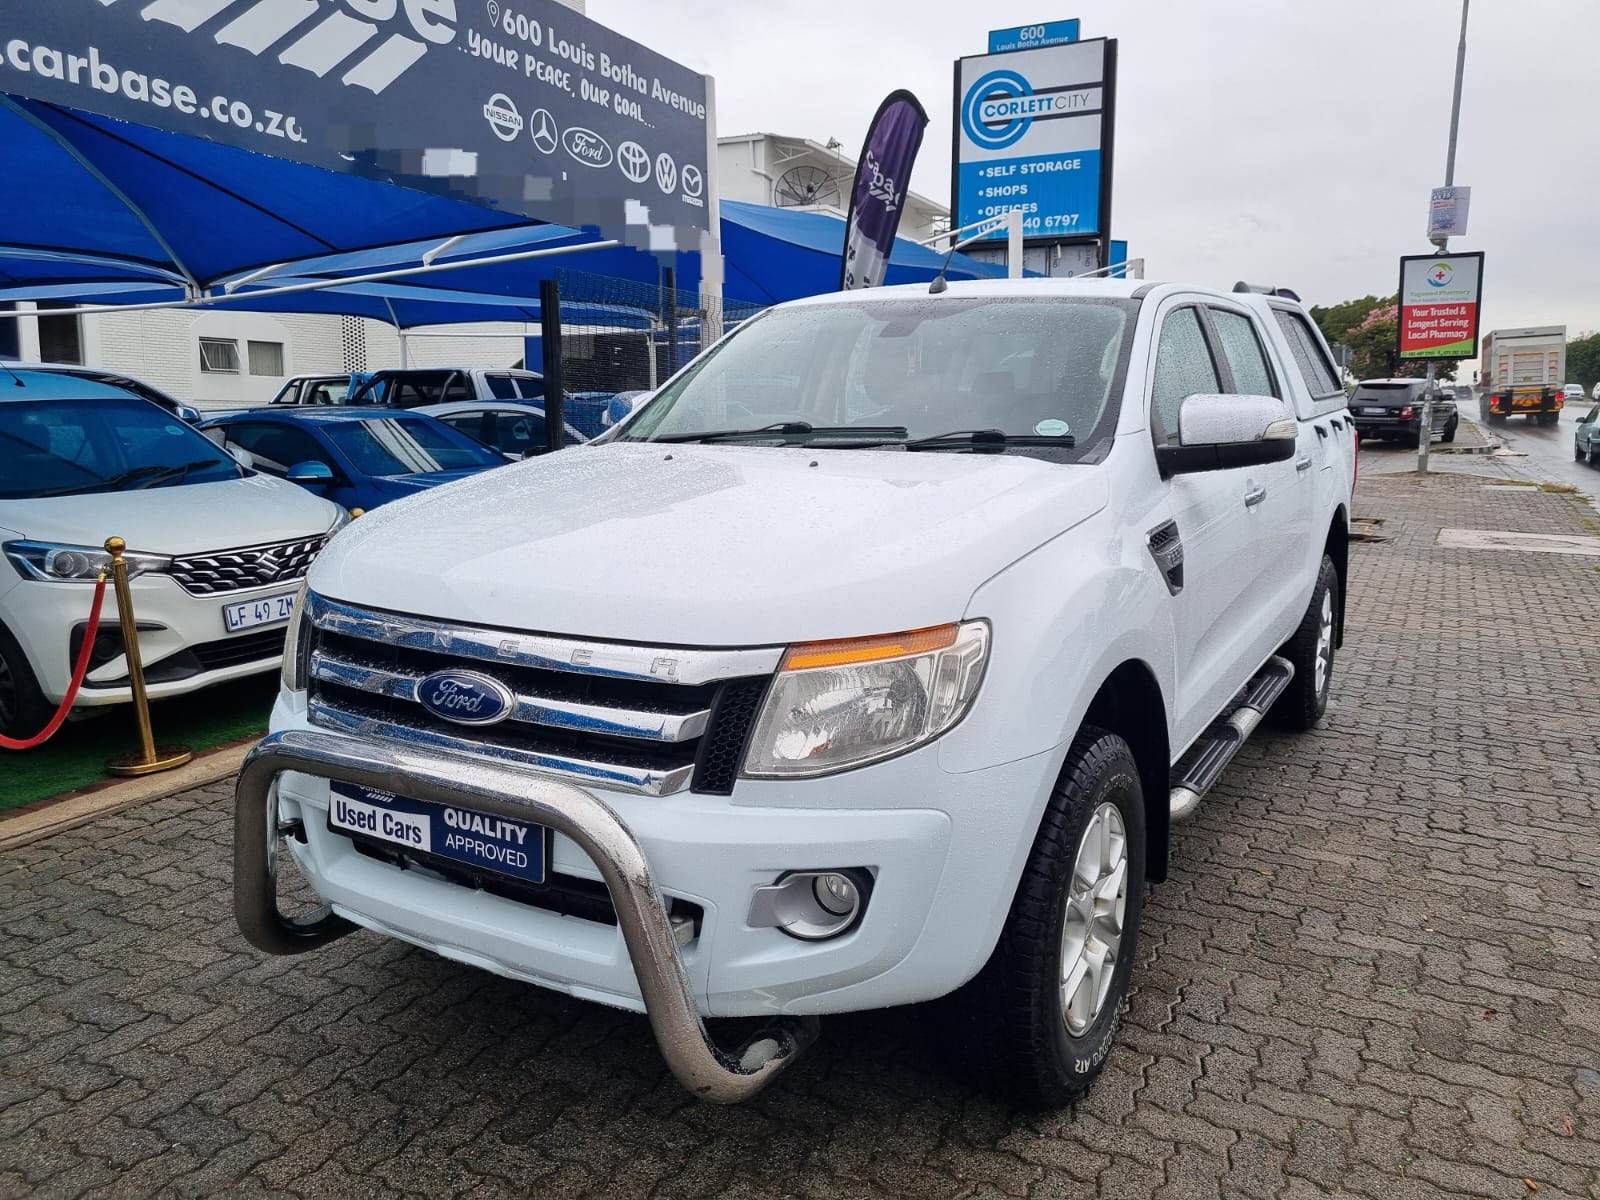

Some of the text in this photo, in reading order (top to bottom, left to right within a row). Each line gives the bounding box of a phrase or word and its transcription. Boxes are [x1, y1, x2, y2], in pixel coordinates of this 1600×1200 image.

[1020, 25, 1046, 41] 600
[996, 35, 1069, 52] Louis Botha Avenue
[503, 8, 542, 47] 600
[548, 27, 595, 71] Louis
[600, 52, 648, 94] Botha
[651, 78, 706, 119] Avenue
[581, 78, 610, 108] OUR
[486, 107, 521, 127] NISSAN
[572, 132, 604, 161] Ford
[986, 158, 1081, 178] SELF STORAGE
[985, 184, 1028, 198] SHOPS
[1044, 213, 1080, 228] 6797
[1412, 306, 1467, 317] Your Trusted &
[1408, 318, 1469, 330] Longest Serving
[1407, 329, 1468, 340] Local Pharmacy
[228, 606, 246, 627] LF
[254, 602, 270, 621] 49
[432, 679, 486, 713] Ford
[335, 799, 528, 845] Used Cars QUALITY
[444, 832, 528, 869] APPROVED
